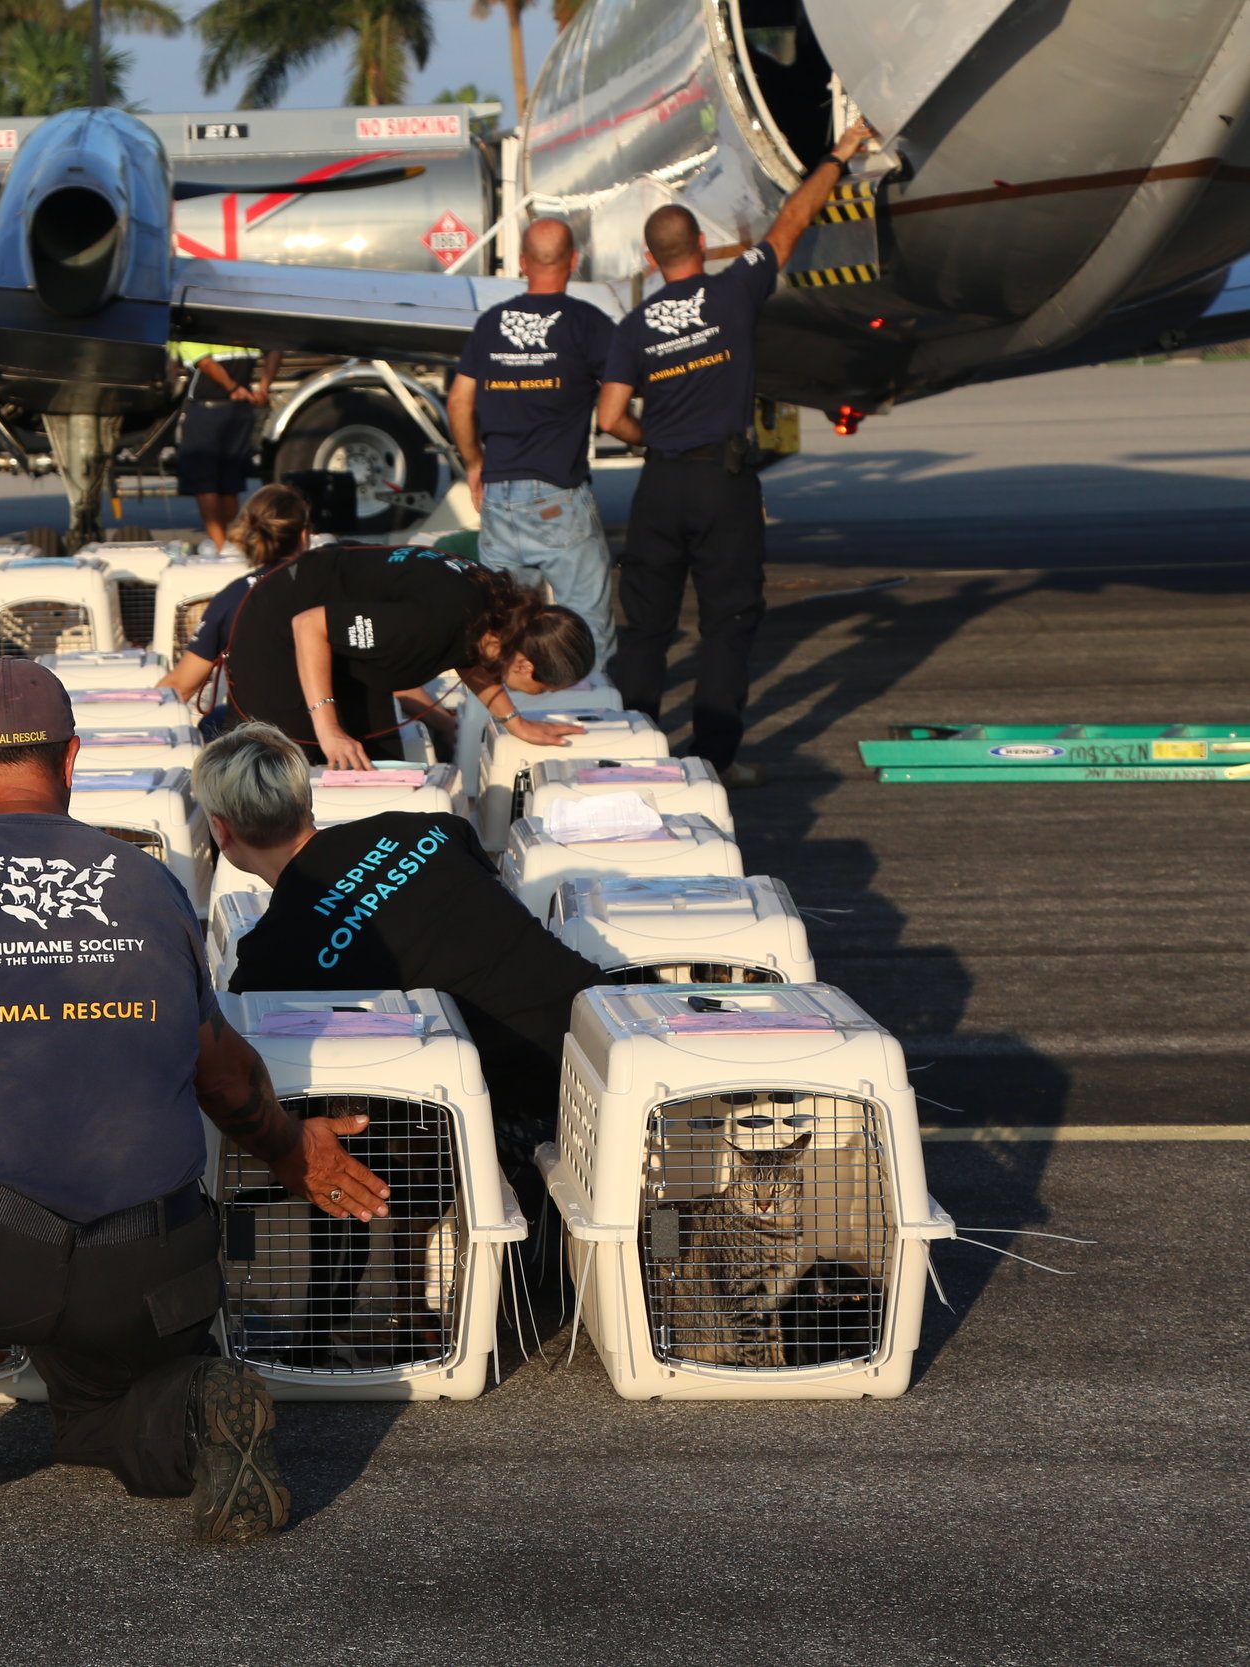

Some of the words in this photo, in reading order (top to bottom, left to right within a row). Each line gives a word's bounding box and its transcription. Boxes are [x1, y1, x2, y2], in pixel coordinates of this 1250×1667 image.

[359, 119, 380, 137] NO
[387, 116, 459, 135] SMOKING
[649, 365, 687, 382] ANIMAL
[687, 352, 724, 370] RESCUE
[520, 379, 553, 389] RESCUE
[348, 625, 358, 647] TEAM
[363, 618, 375, 648] SPECIAL
[13, 731, 47, 743] RESCUE
[312, 837, 400, 917] INSPIRE
[317, 825, 450, 969] COMPASSION
[79, 938, 145, 952] SOCIETY
[5, 957, 28, 966] THE
[31, 955, 73, 965] UNITED
[77, 953, 115, 963] STATES
[62, 1002, 143, 1020] RESCUE
